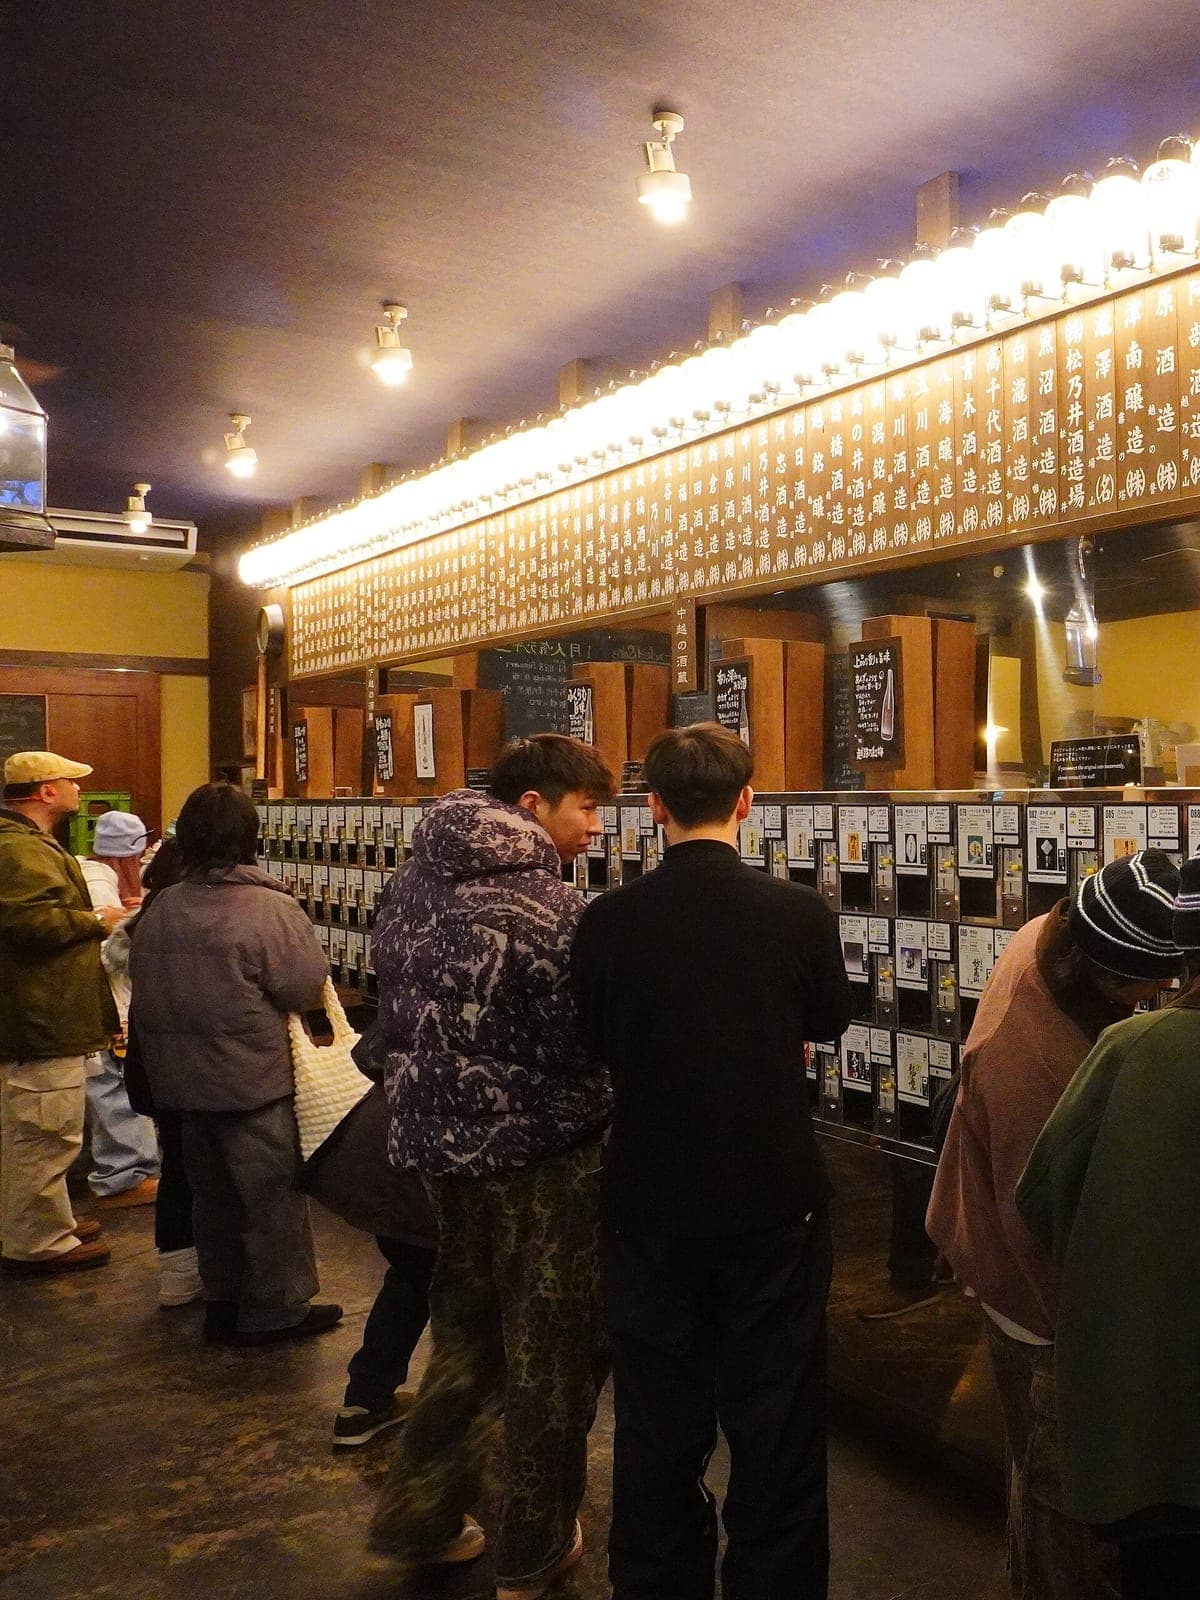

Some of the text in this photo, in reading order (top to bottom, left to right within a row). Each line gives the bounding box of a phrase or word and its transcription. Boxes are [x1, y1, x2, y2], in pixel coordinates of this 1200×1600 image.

[676, 607, 688, 685] 中越の酒蔵
